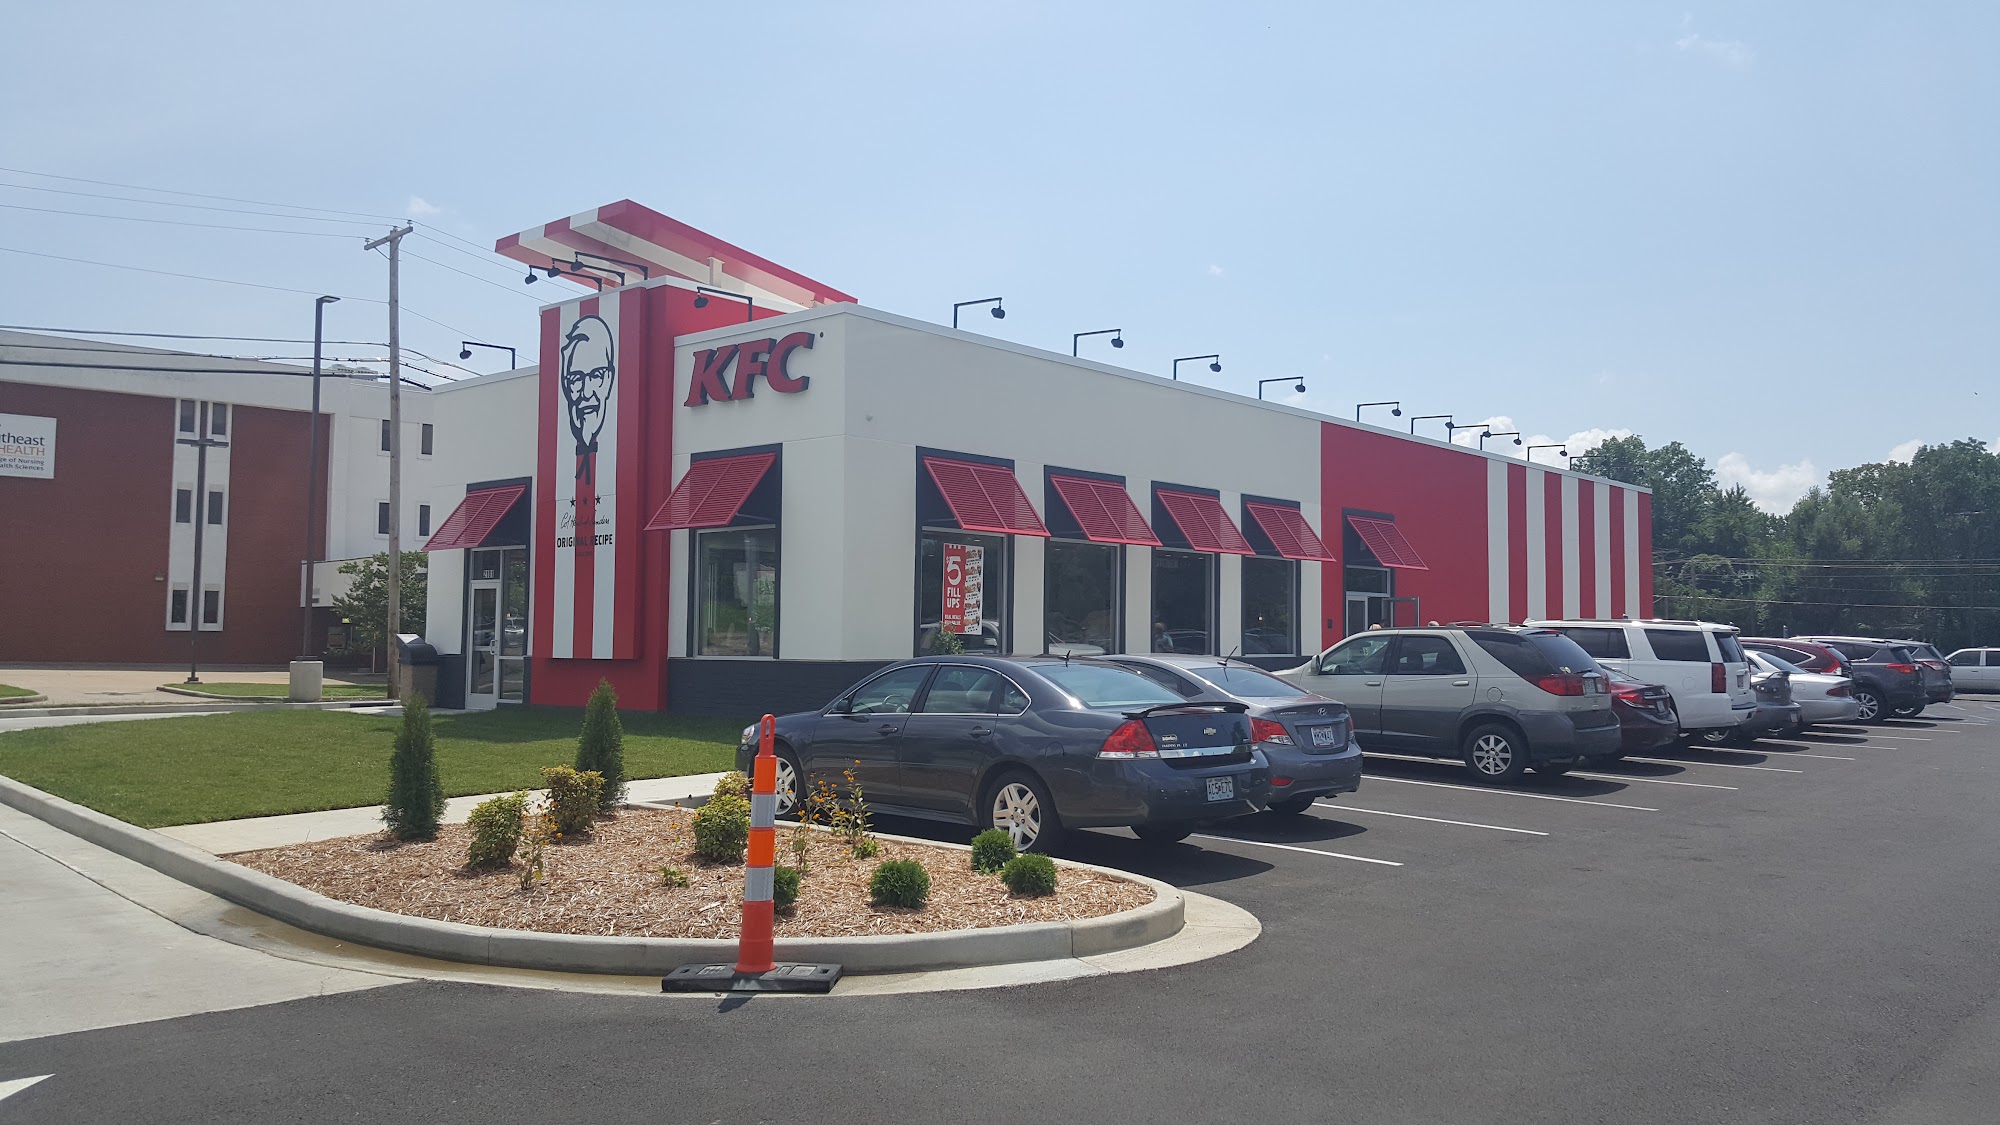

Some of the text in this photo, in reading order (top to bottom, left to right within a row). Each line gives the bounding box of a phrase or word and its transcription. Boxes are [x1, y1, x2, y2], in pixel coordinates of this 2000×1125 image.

[684, 332, 815, 407] KFC
[0, 432, 45, 446] theast
[15, 463, 45, 471] Sciences
[18, 458, 44, 466] Nursing
[557, 533, 613, 548] ORIGINAL RECIPE
[947, 587, 961, 598] FILL
[947, 598, 960, 608] UPS
